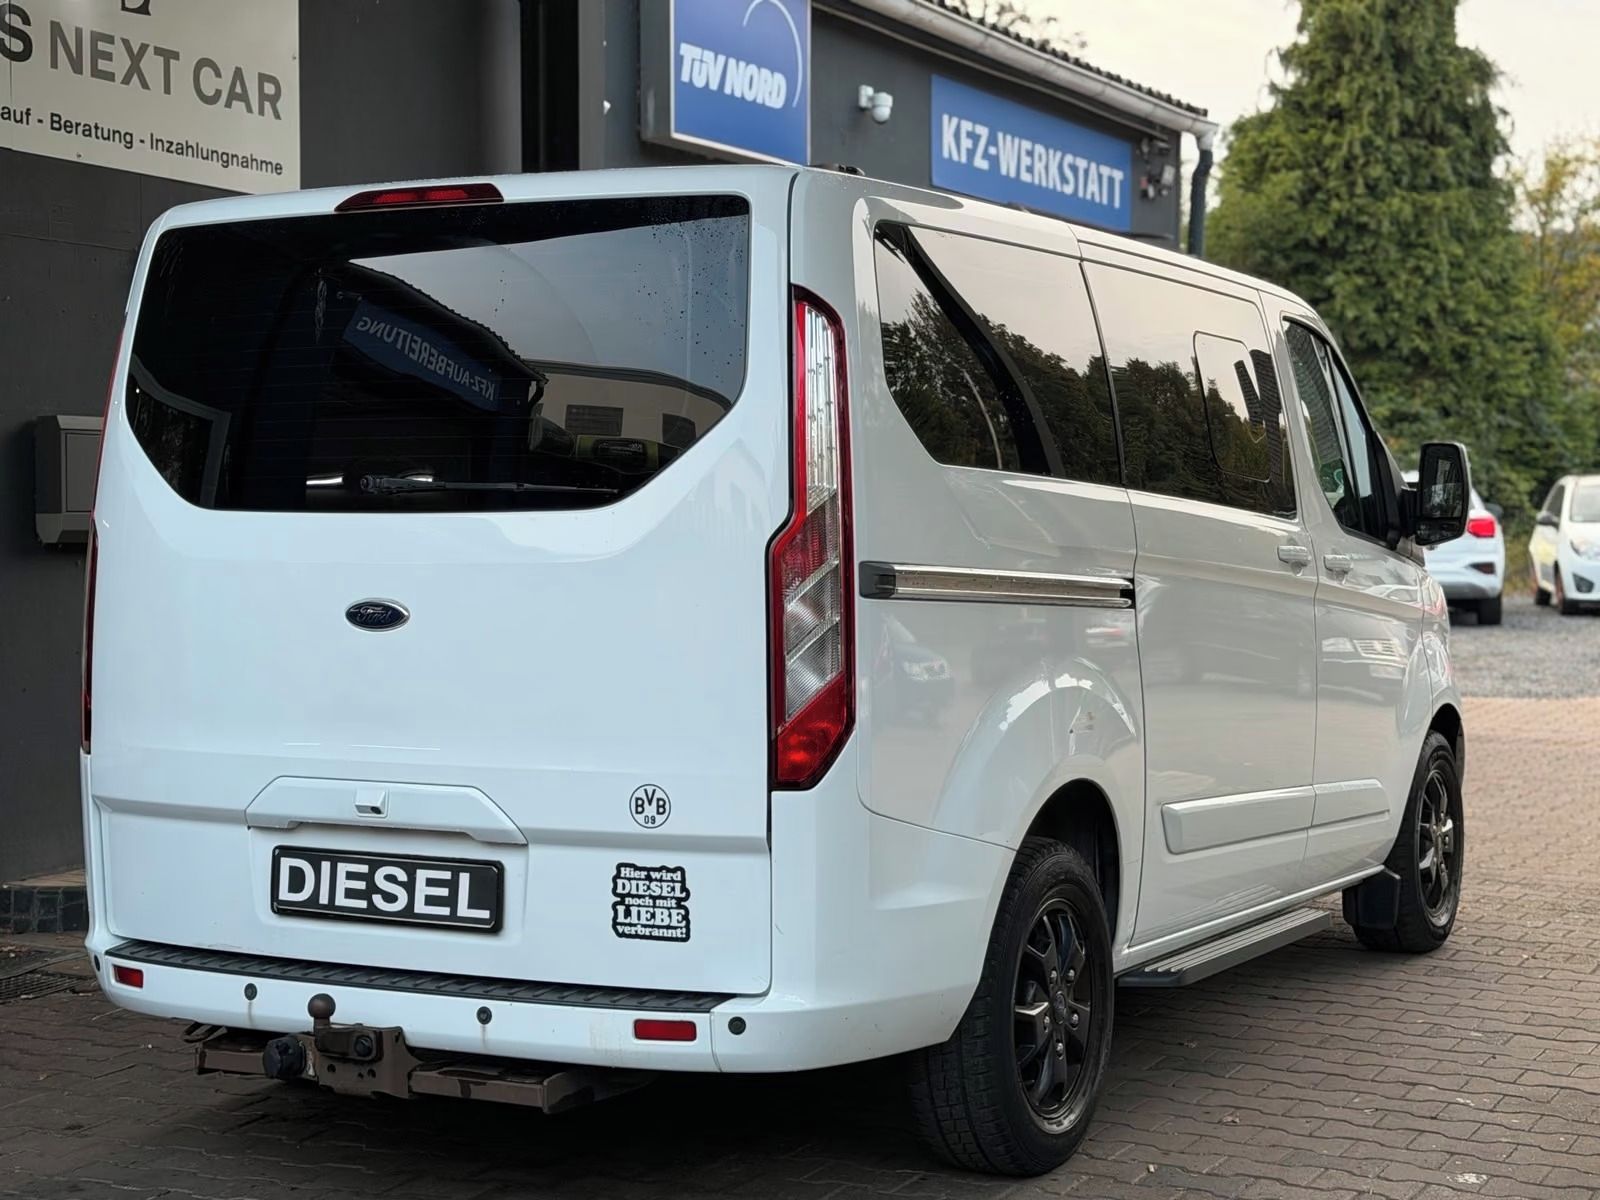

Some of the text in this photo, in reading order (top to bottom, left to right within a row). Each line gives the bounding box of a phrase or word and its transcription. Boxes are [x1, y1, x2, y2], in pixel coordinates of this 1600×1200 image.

[50, 20, 180, 95] NEXT
[192, 57, 282, 120] CAR
[680, 42, 787, 109] TÜV NORD
[50, 113, 133, 149] Beratung
[150, 133, 283, 175] Inzahlungnahme
[941, 113, 1125, 209] KFZ-WERKSTATT
[634, 788, 667, 815] BVB
[643, 815, 656, 825] 09
[620, 867, 682, 881] Hier wird
[278, 857, 490, 919] DIESEL
[616, 879, 686, 898] DIESEL
[625, 897, 677, 908] noch mit
[616, 905, 686, 927] LIEBE
[616, 925, 686, 938] verbrannt!
